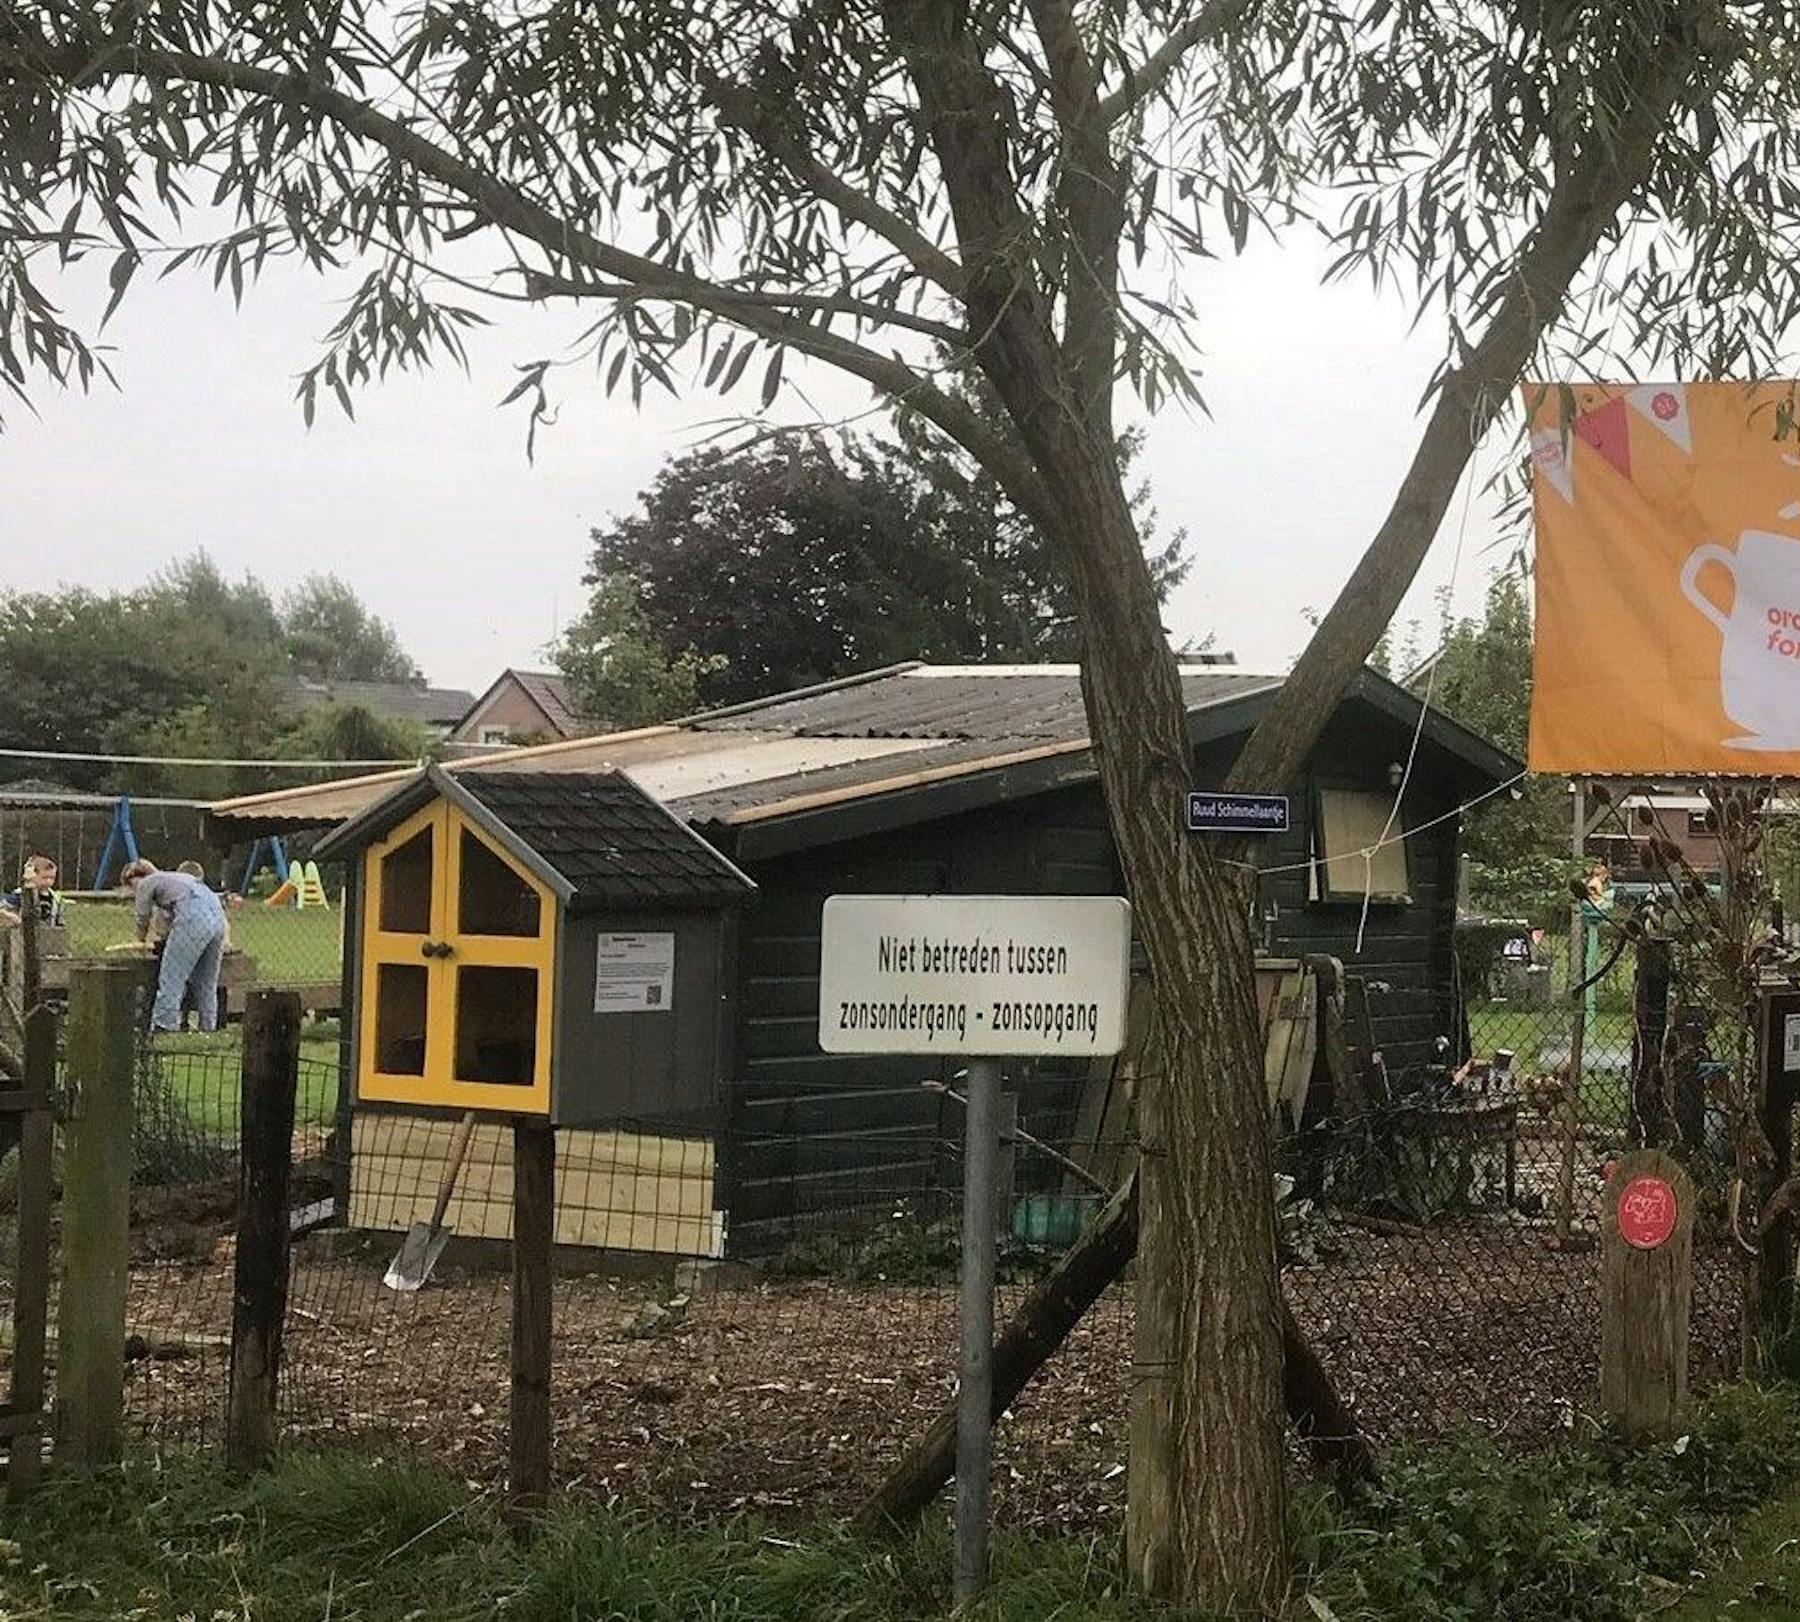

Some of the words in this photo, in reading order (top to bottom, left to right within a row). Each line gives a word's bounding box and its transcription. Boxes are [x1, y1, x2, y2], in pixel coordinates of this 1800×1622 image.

[1193, 801, 1216, 817] Ruud
[878, 936, 916, 973] Niet
[923, 936, 1000, 973] betreden
[1007, 939, 1067, 974] tussen
[840, 994, 966, 1041] zonsondergang
[992, 1002, 1098, 1043] zonsopgang
